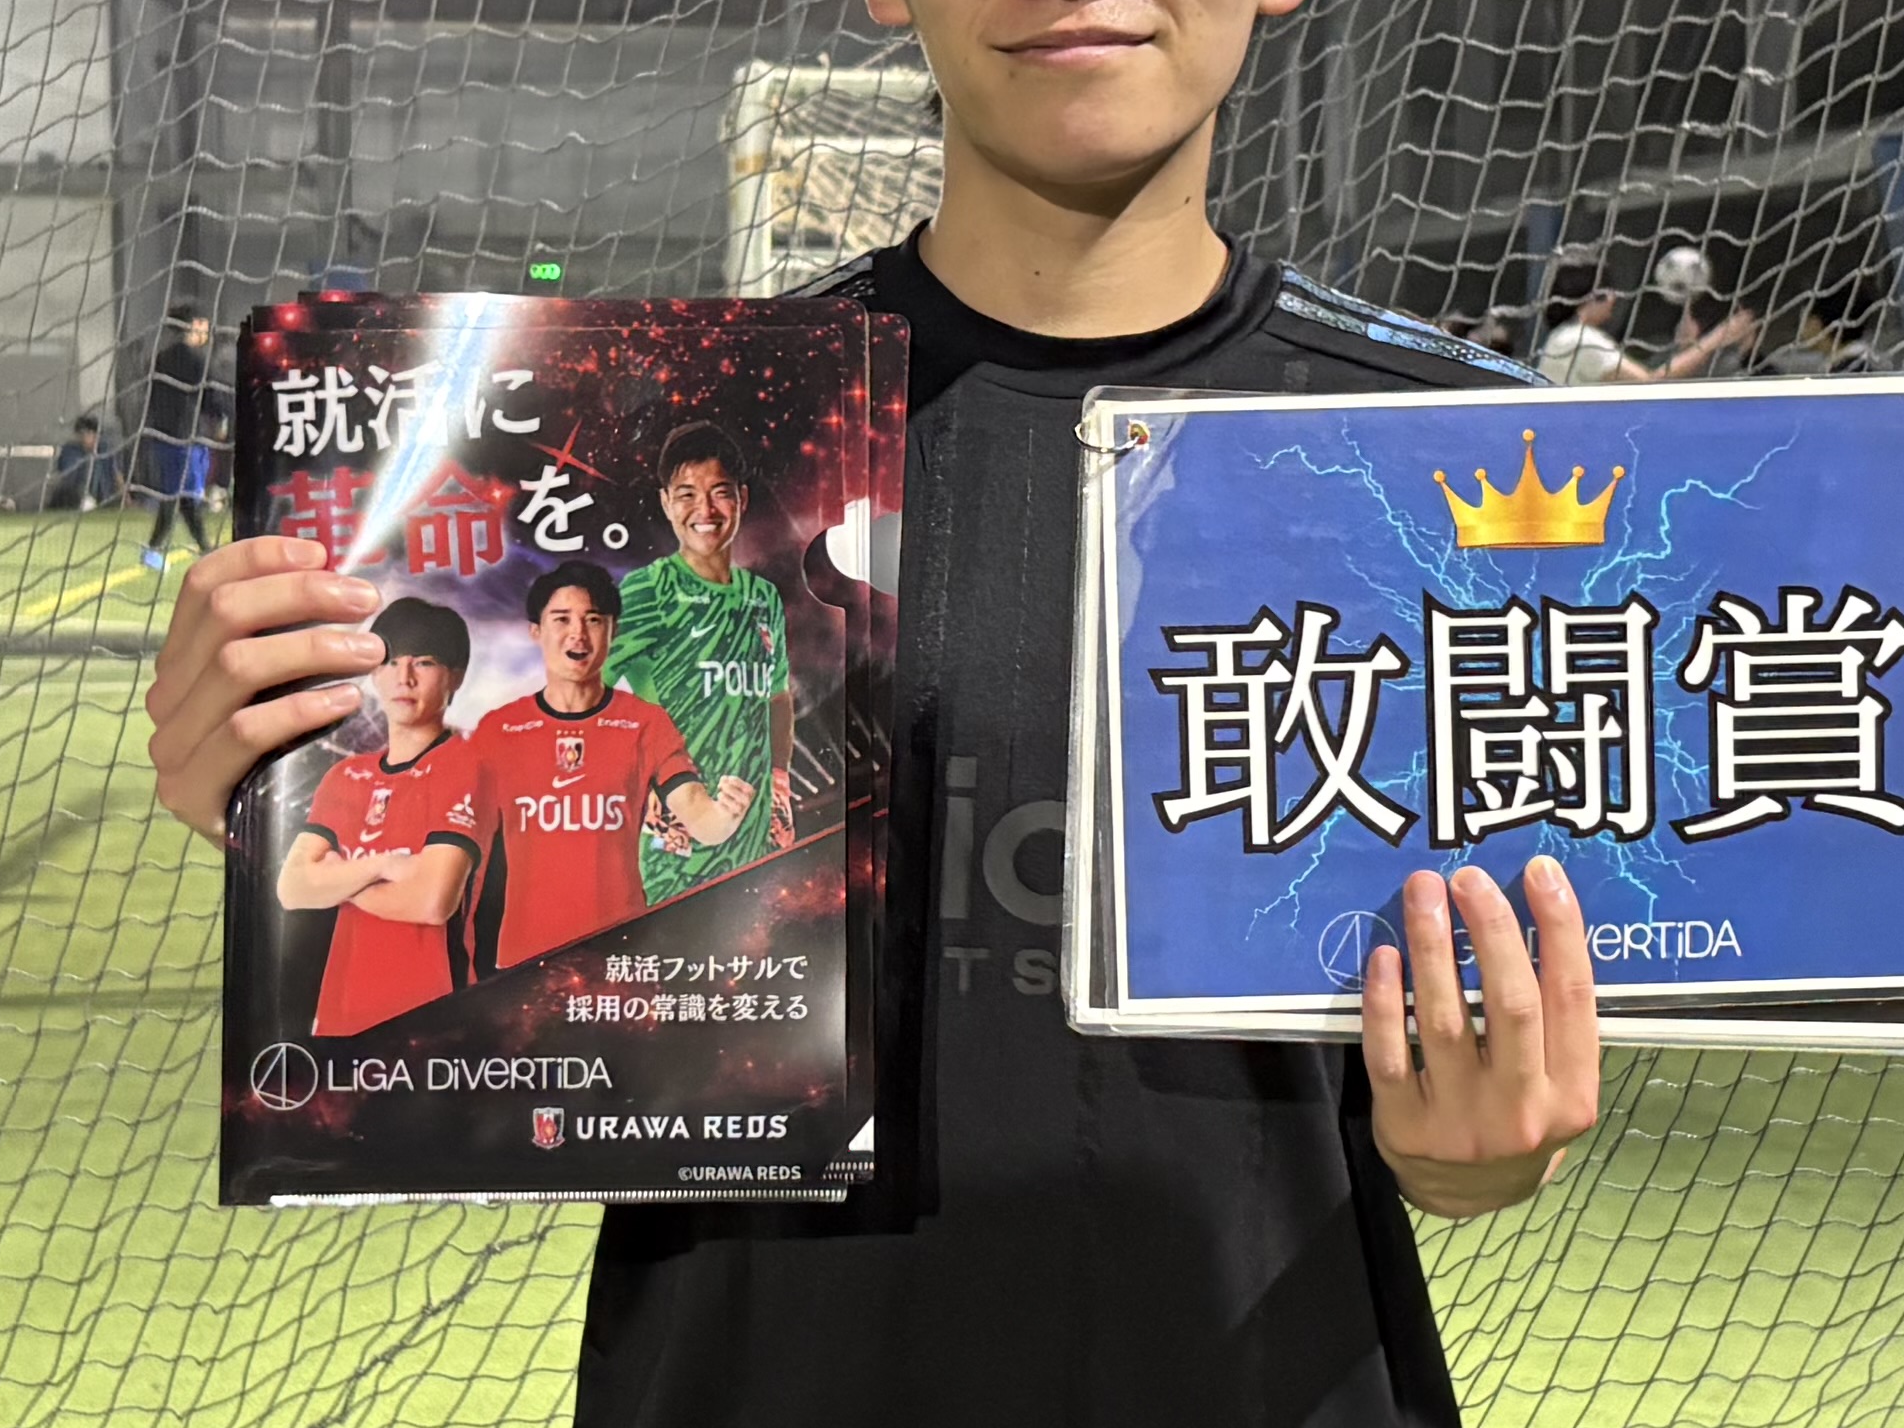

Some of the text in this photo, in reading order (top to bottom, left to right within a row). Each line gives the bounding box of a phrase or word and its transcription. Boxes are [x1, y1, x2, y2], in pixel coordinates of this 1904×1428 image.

[514, 793, 627, 833] POLUS
[604, 954, 809, 983] 就活フットサルで
[565, 993, 809, 1023] 採用の常識を変える
[576, 1114, 789, 1141] URAWA REDS
[756, 1164, 802, 1182] REDS
